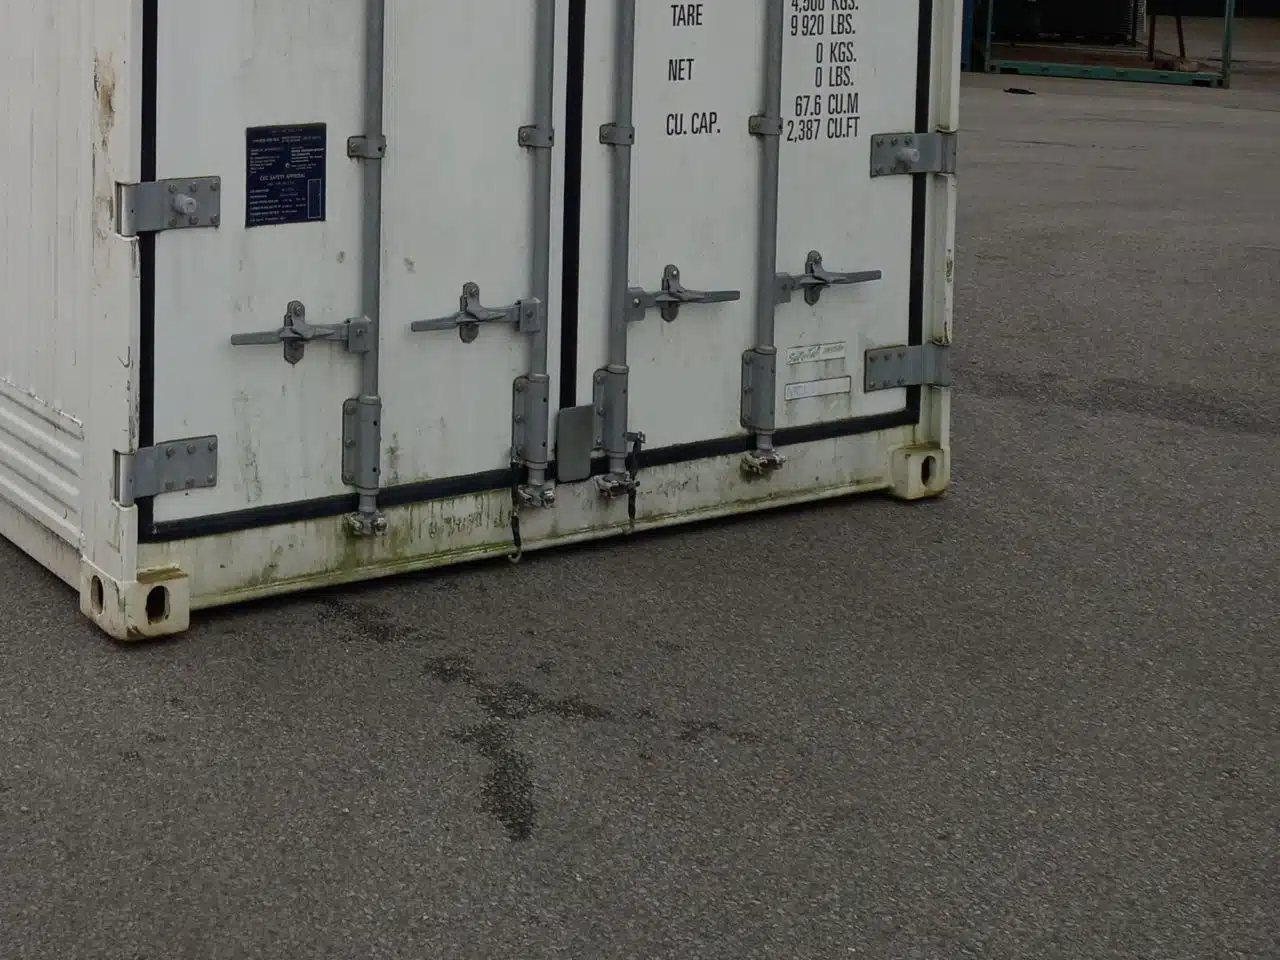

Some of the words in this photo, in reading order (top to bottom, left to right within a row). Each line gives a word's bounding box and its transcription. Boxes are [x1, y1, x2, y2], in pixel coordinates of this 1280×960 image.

[671, 4, 703, 26] TARE
[830, 13, 856, 35] LBS.
[815, 42, 823, 63] 0
[829, 41, 857, 63] KGS.
[668, 58, 694, 81] NET
[815, 66, 823, 87] 0
[828, 65, 854, 87] LBS.
[795, 94, 821, 116] 67.6
[827, 92, 858, 114] CU.M
[666, 113, 688, 135] CU.
[691, 112, 721, 134] CAP.
[787, 119, 821, 142] 2,387
[827, 116, 860, 138] CU.FT
